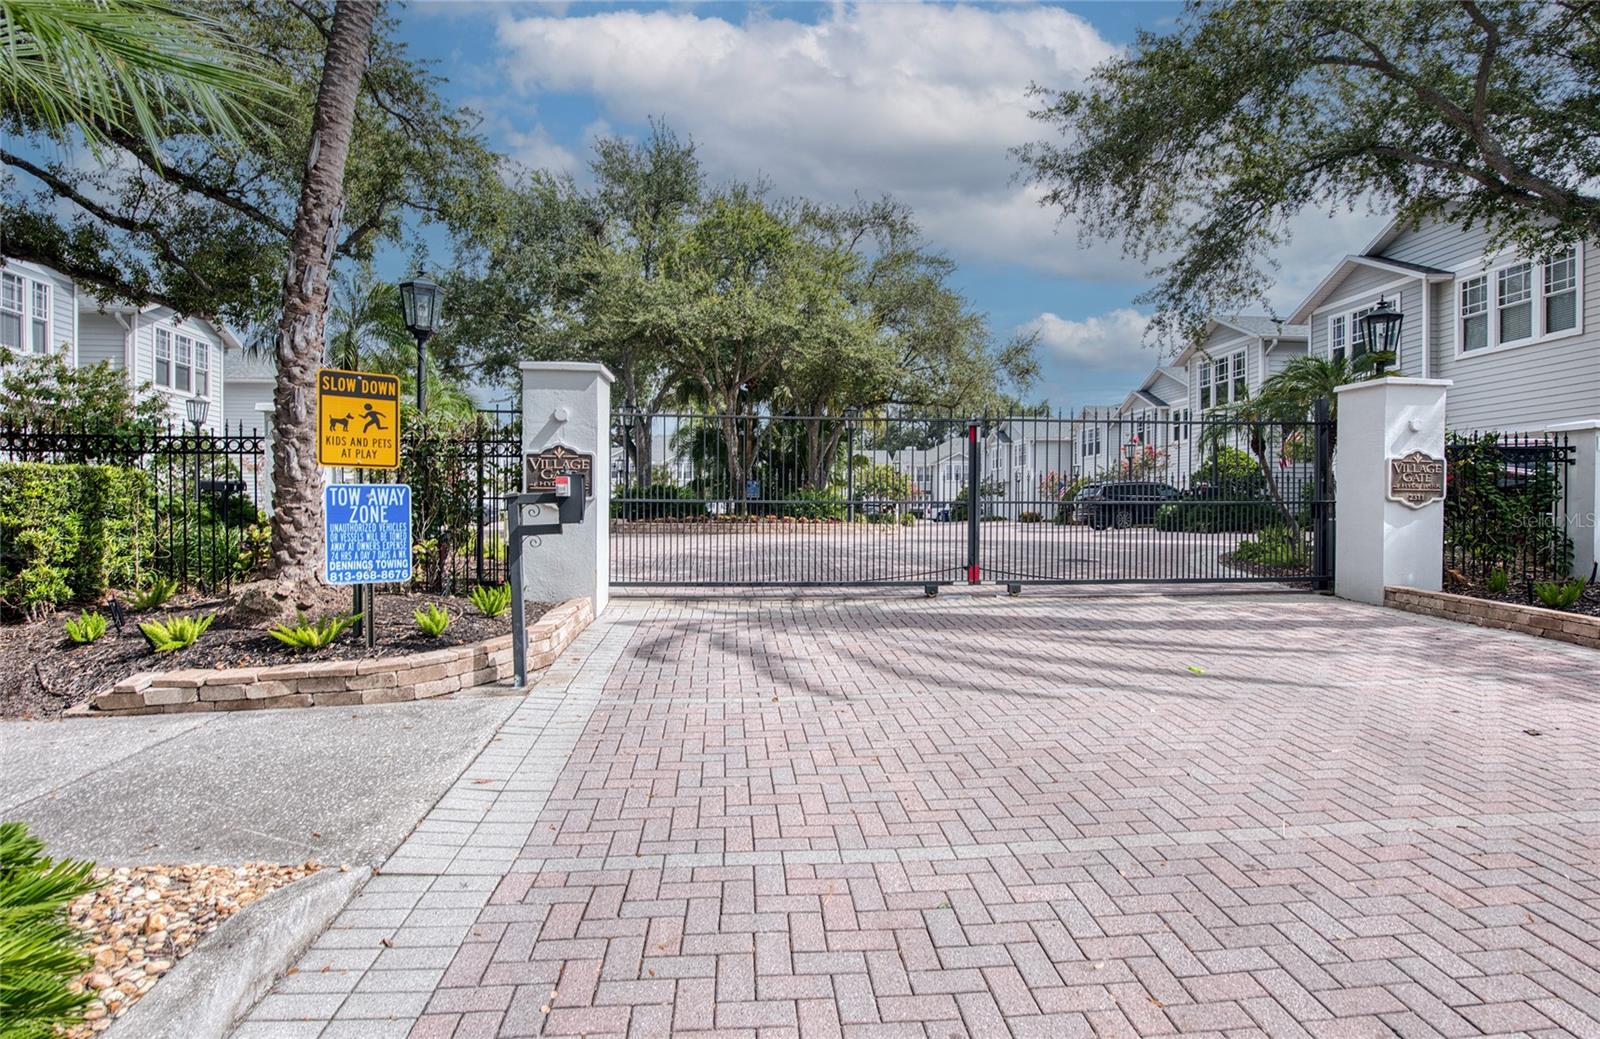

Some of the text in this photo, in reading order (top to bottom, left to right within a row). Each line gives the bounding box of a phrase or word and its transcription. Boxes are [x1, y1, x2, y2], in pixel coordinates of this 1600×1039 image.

[322, 376, 396, 396] SLOW DOWN
[326, 436, 392, 448] KIDS AND PETS
[341, 449, 377, 459] AT PLAY
[528, 458, 590, 469] VILLAGE
[1393, 463, 1442, 473] VILLAGE
[1403, 473, 1432, 482] GATE
[330, 487, 406, 506] TOW AWAY
[349, 506, 389, 523] ZONE
[330, 523, 407, 532] UNAUTHORIZED VEHICLES
[330, 532, 407, 542] OR VESSELS WILL BE TOWED
[331, 543, 346, 552] AWAY
[348, 542, 355, 551] AT
[383, 542, 407, 550] EXPENSE
[331, 552, 339, 561] 24
[341, 552, 352, 560] HRS
[354, 551, 359, 560] A
[360, 551, 370, 560] DAY
[372, 551, 376, 559] 7
[378, 551, 390, 560] DAYS
[393, 551, 397, 559] A
[329, 559, 408, 571] DENNINGS TOWING
[330, 569, 408, 582] 813-968-8676
